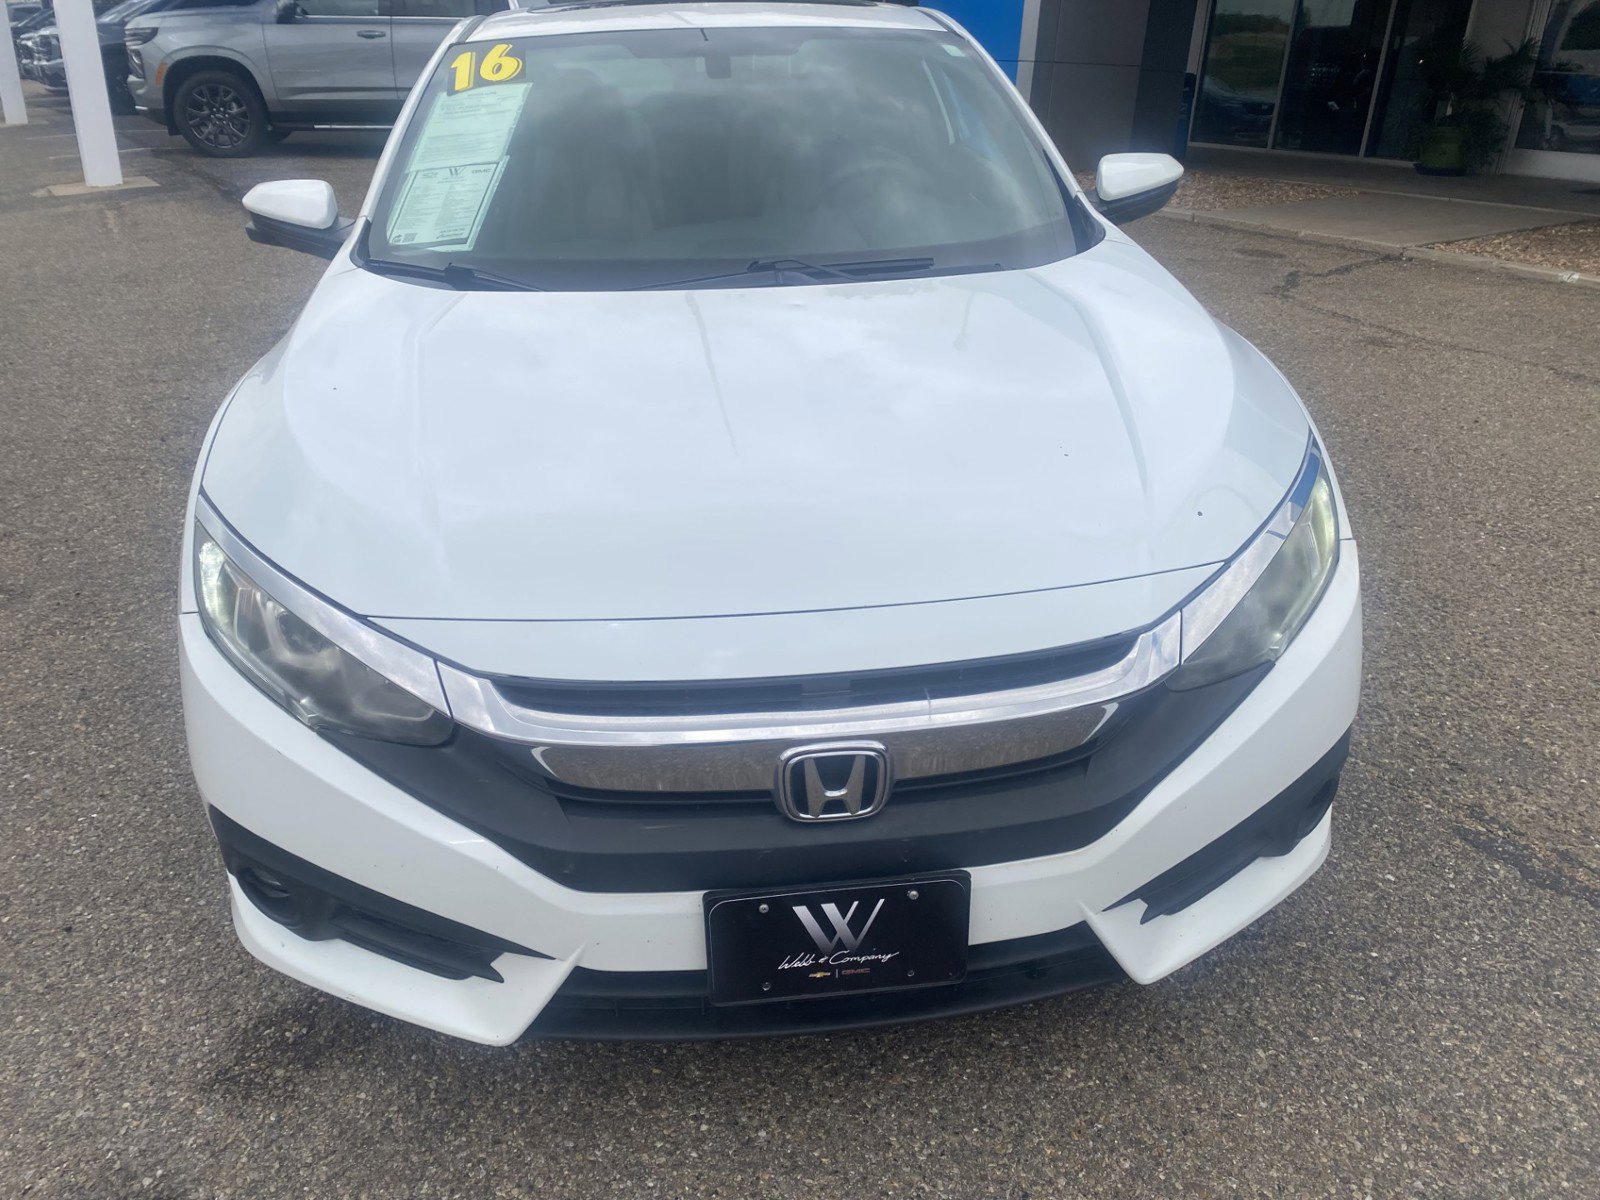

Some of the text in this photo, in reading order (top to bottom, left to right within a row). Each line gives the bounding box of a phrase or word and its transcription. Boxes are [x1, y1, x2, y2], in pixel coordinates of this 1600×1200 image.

[451, 44, 523, 91] 16
[778, 952, 815, 970] Webb
[829, 949, 900, 964] Company
[841, 967, 871, 975] GMC
